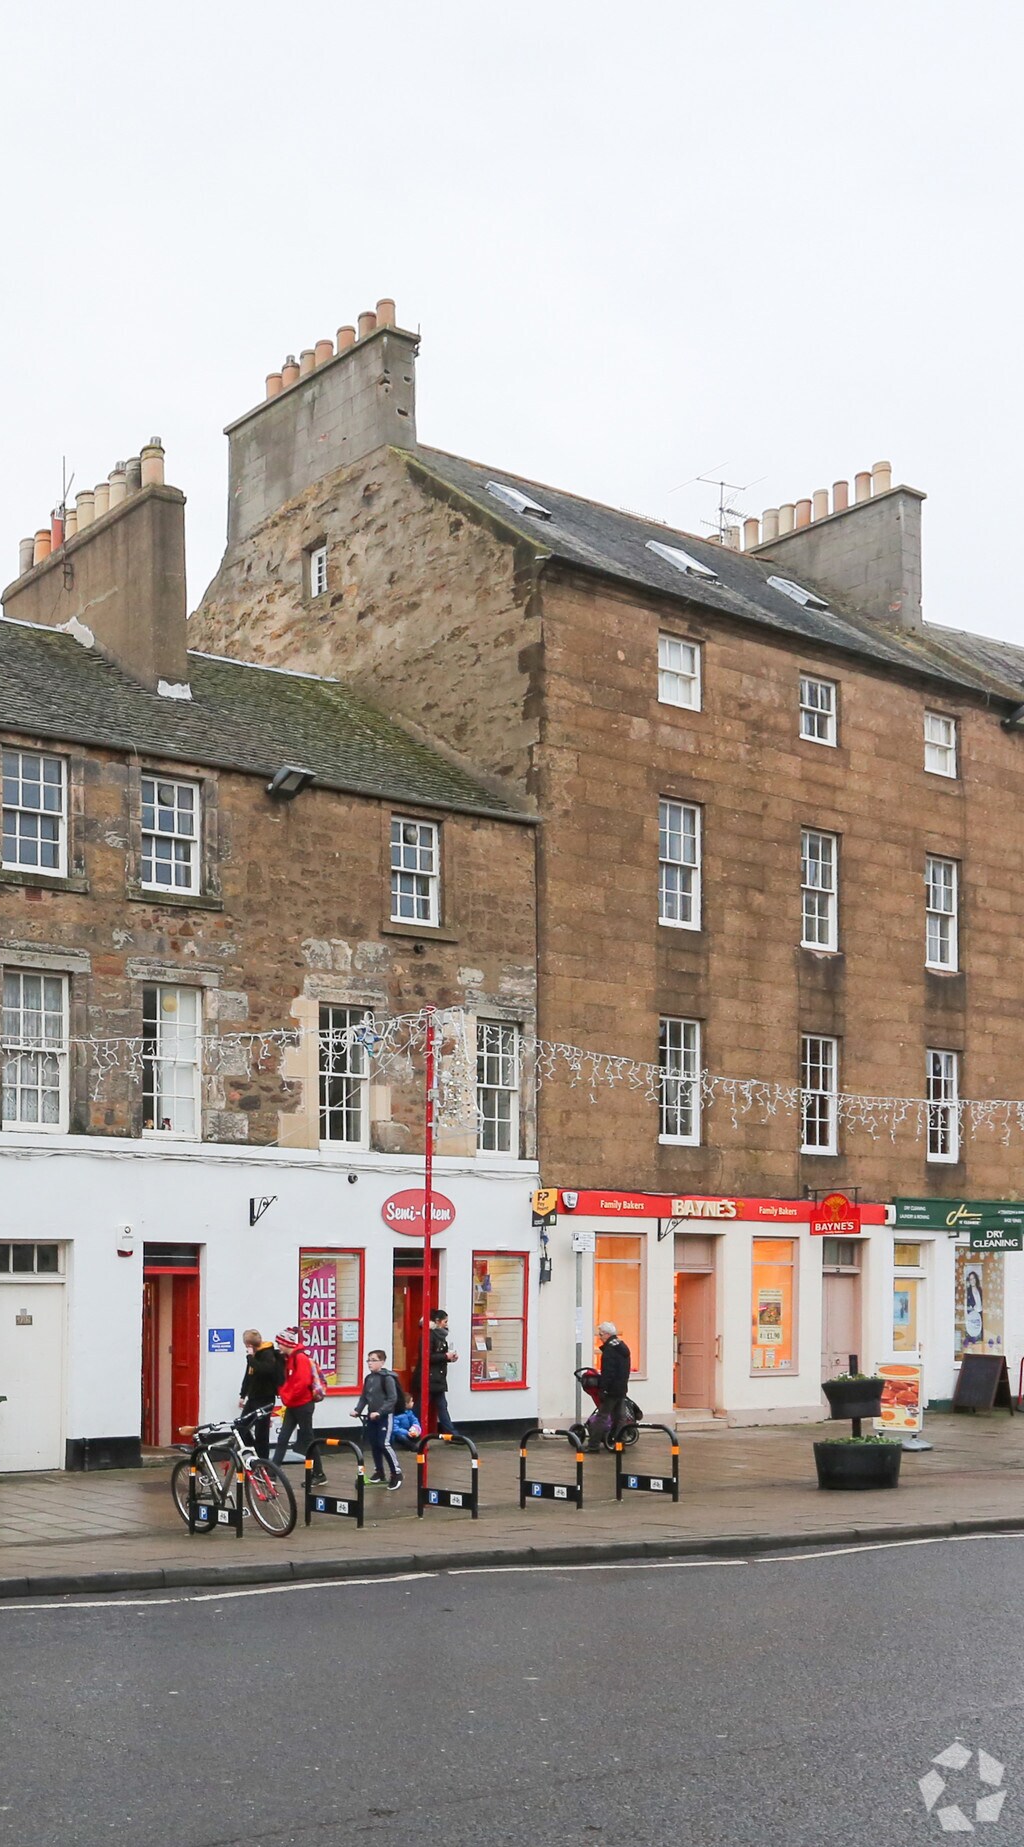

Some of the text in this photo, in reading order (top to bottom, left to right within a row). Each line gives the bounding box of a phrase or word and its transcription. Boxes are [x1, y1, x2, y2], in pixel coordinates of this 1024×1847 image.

[600, 1199, 645, 1211] Family Bakers
[758, 1206, 797, 1216] Family Bakers
[815, 1221, 854, 1231] BAYNE'S
[986, 1230, 1004, 1239] DRY
[973, 1239, 1018, 1248] CLEANING
[302, 1277, 336, 1299] SALE
[302, 1301, 336, 1319] SALE
[302, 1325, 336, 1347] SALE
